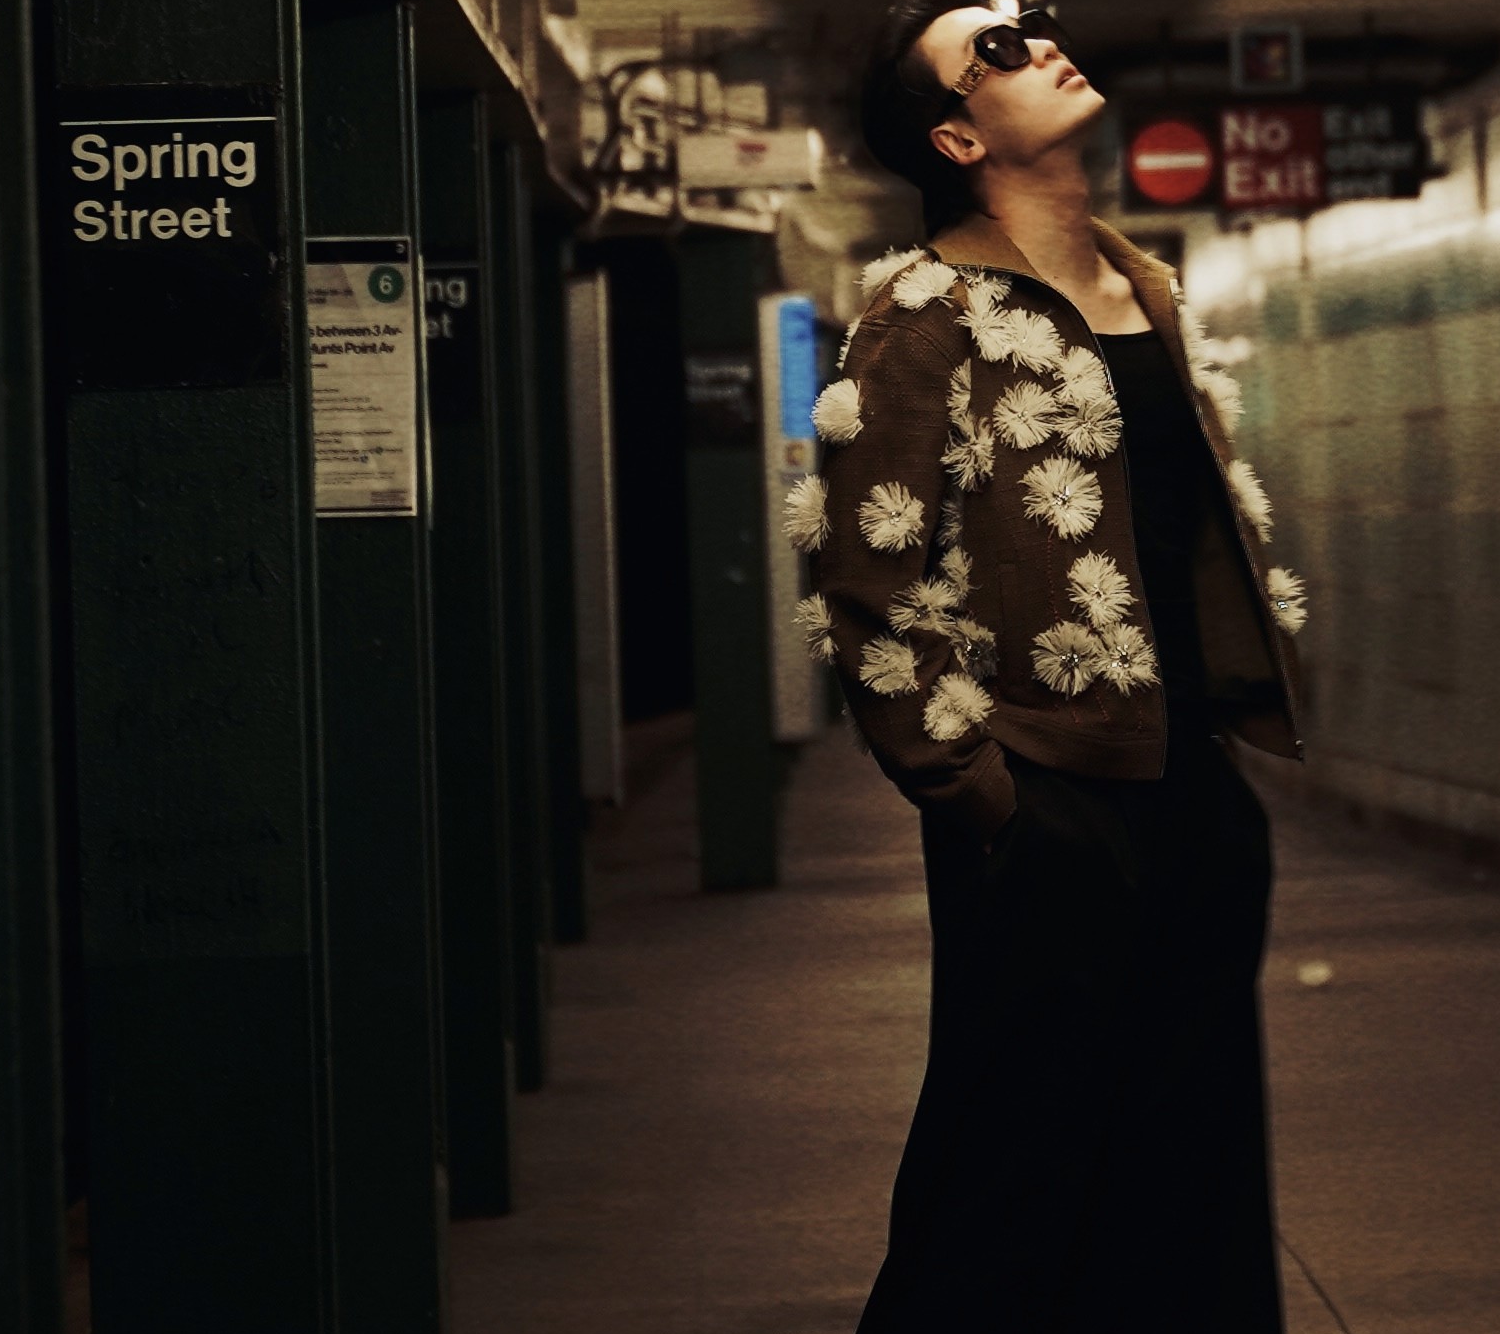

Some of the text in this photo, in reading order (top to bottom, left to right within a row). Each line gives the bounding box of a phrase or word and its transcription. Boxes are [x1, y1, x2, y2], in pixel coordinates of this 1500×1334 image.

[1222, 109, 1293, 152] No
[71, 132, 257, 191] Spring
[1224, 157, 1320, 201] Exit
[72, 197, 233, 242] Street
[377, 275, 393, 294] 6
